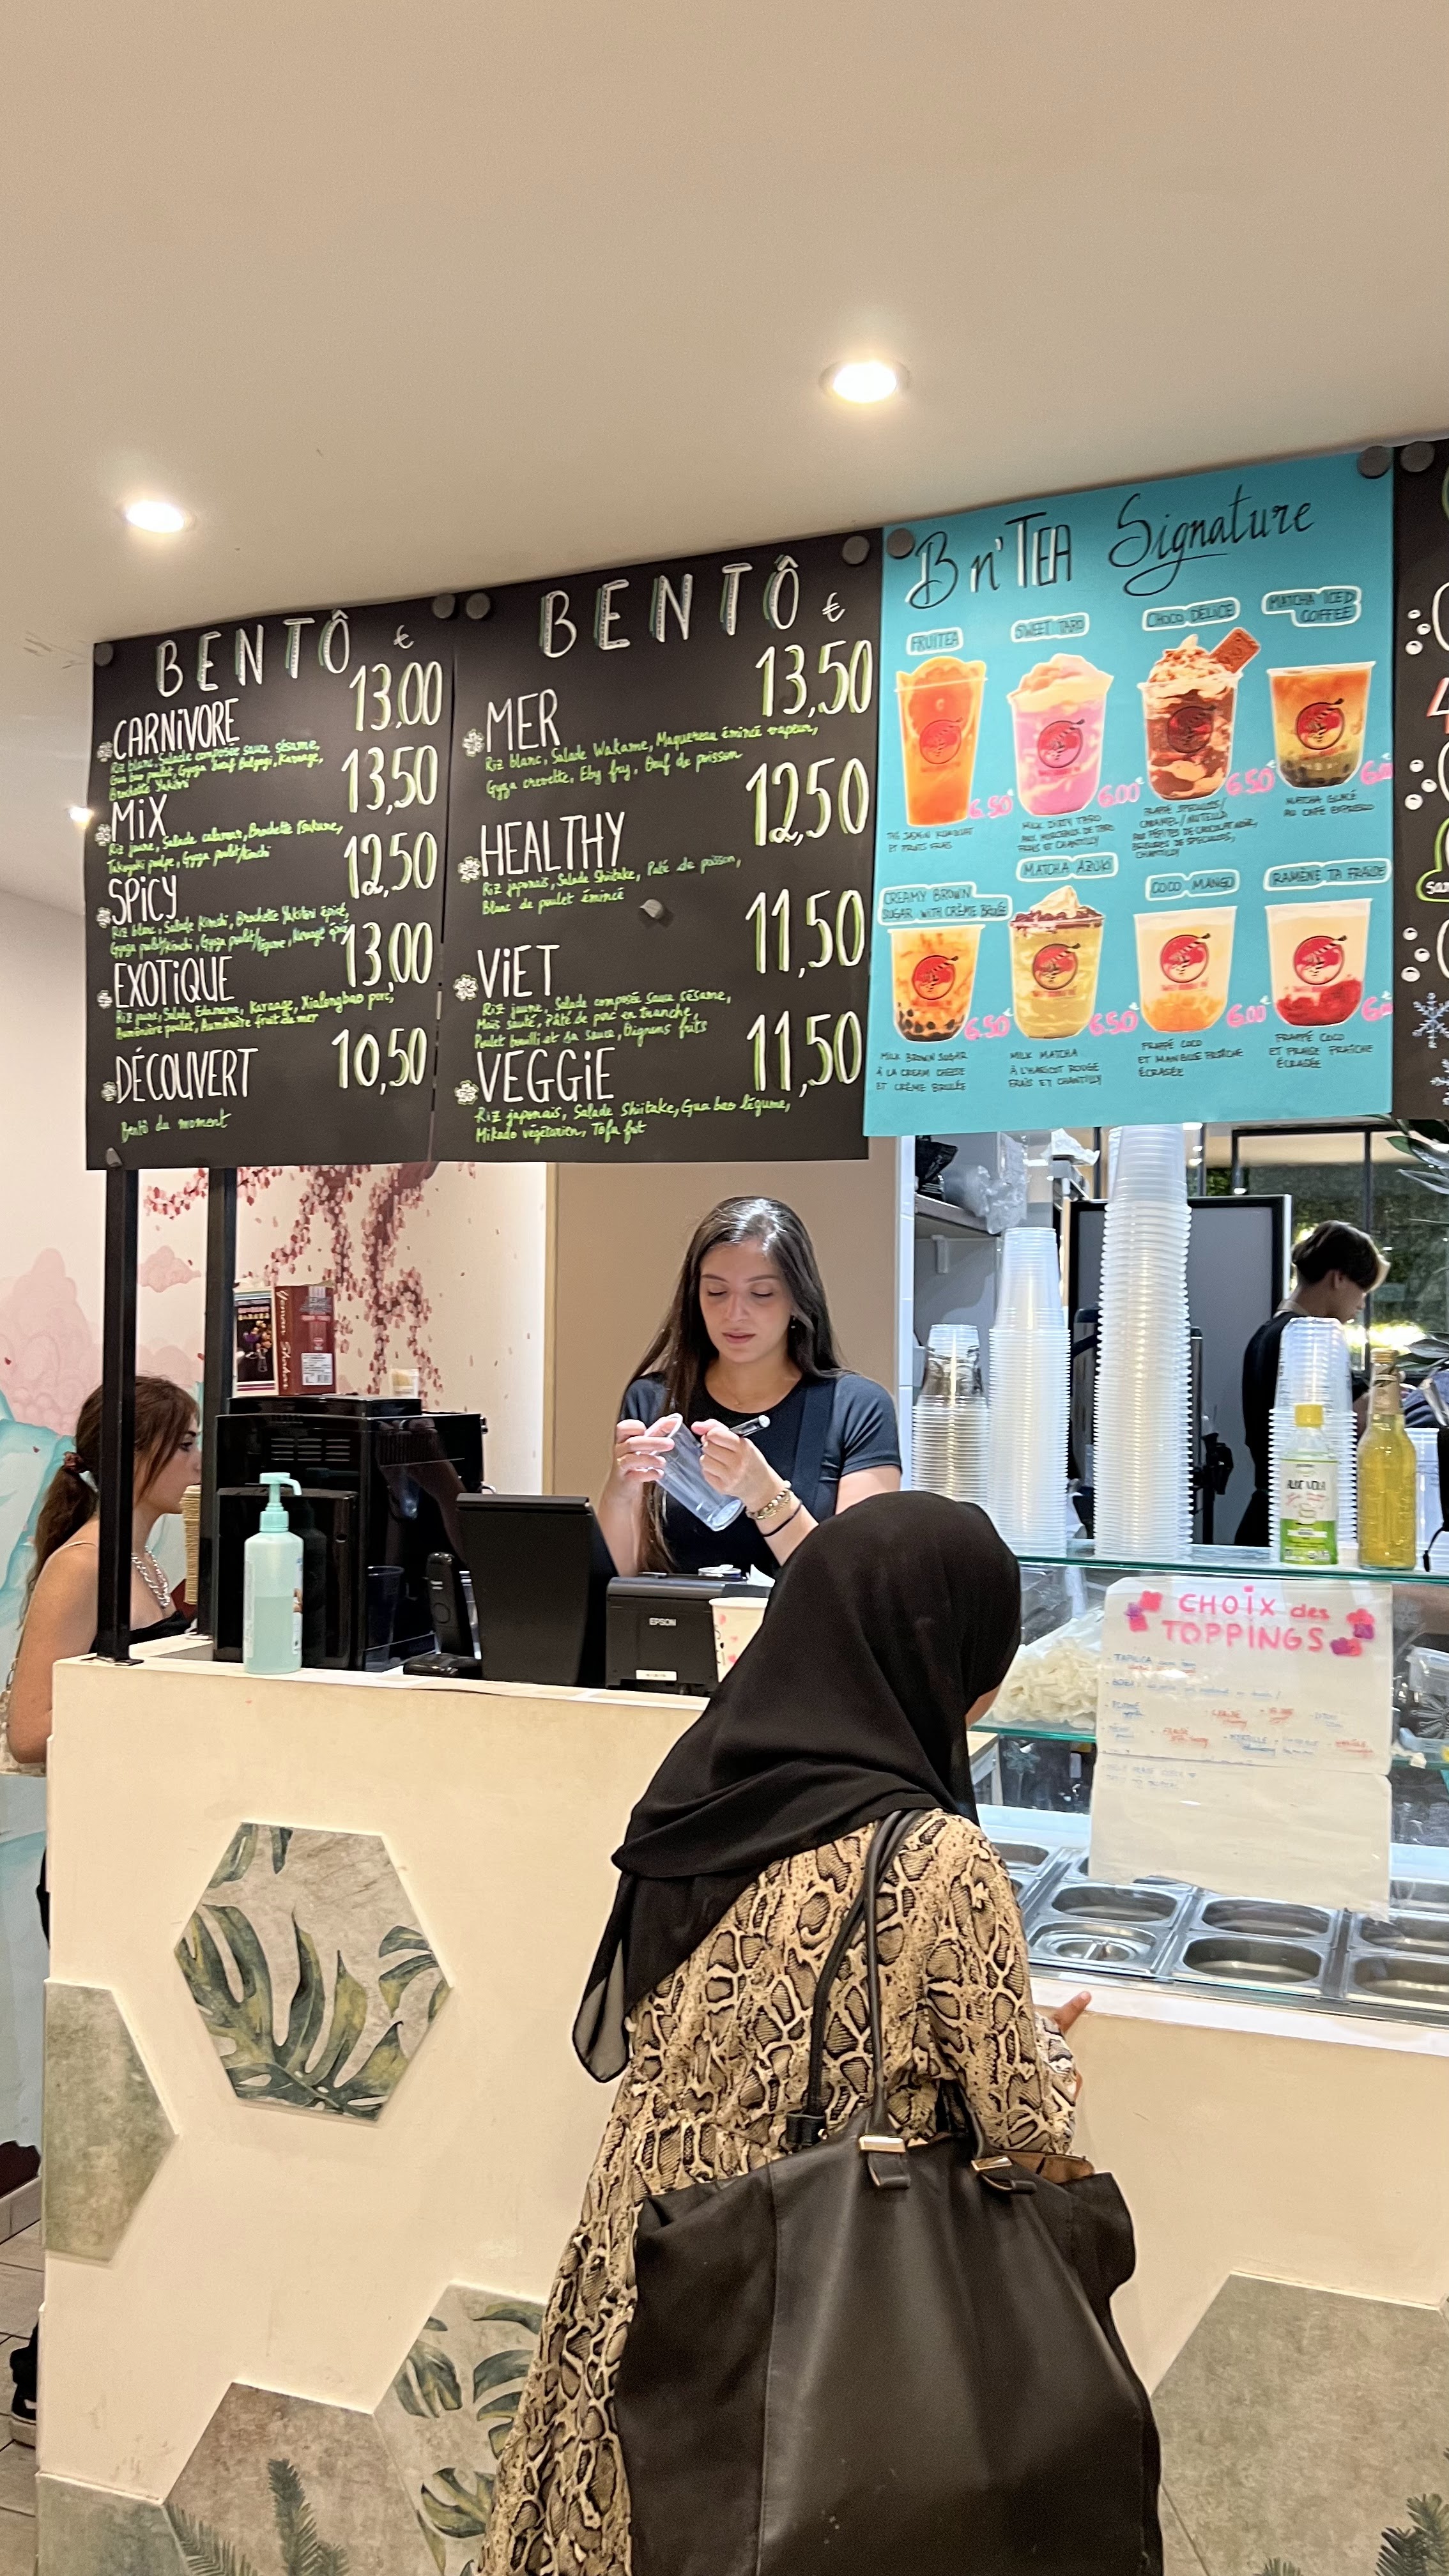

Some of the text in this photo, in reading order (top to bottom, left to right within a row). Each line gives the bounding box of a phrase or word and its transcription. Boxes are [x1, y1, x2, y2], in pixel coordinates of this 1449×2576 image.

[1108, 484, 1316, 596] Signature
[539, 554, 845, 658] BENTÔ €
[1268, 590, 1357, 610] MATCHA ICED
[1147, 612, 1184, 627] CHOCO
[1300, 607, 1353, 622] COFFEE
[910, 631, 959, 652] FRUITEA
[1016, 618, 1086, 640] SWEET TARO
[156, 609, 415, 698] BENTÔ €
[755, 639, 874, 717] 13,50
[349, 661, 443, 732] 13,00
[487, 689, 561, 753] MER
[486, 756, 504, 772] Riz
[551, 744, 587, 764] Salade
[675, 752, 692, 768] de
[342, 745, 438, 815] 13,50
[746, 758, 870, 847] 12,50
[163, 832, 197, 850] Salade
[480, 811, 625, 877] HEALTHY
[344, 832, 438, 899] 12,50
[482, 882, 502, 896] Riz
[556, 871, 590, 885] Salade
[677, 857, 696, 872] de
[1023, 862, 1070, 877] MATCHA
[1151, 880, 1182, 894] COCO
[482, 900, 512, 915] Blanc
[519, 898, 534, 910] de
[538, 891, 575, 915] poulet
[745, 889, 865, 978] 11,50
[341, 922, 433, 992] 13,00
[482, 1002, 505, 1016] Riz
[555, 993, 588, 1011] Salade
[573, 1011, 588, 1024] de
[331, 1027, 428, 1095] 10,50
[746, 1010, 863, 1098] 11,50
[116, 1046, 259, 1104] DÉCOUVERT
[155, 1114, 171, 1131] du
[474, 1107, 502, 1123] Riz
[574, 1103, 613, 1120] Salade
[476, 1126, 518, 1143] Mikado
[648, 1617, 677, 1627] EPSON
[1290, 1604, 1331, 1621] des
